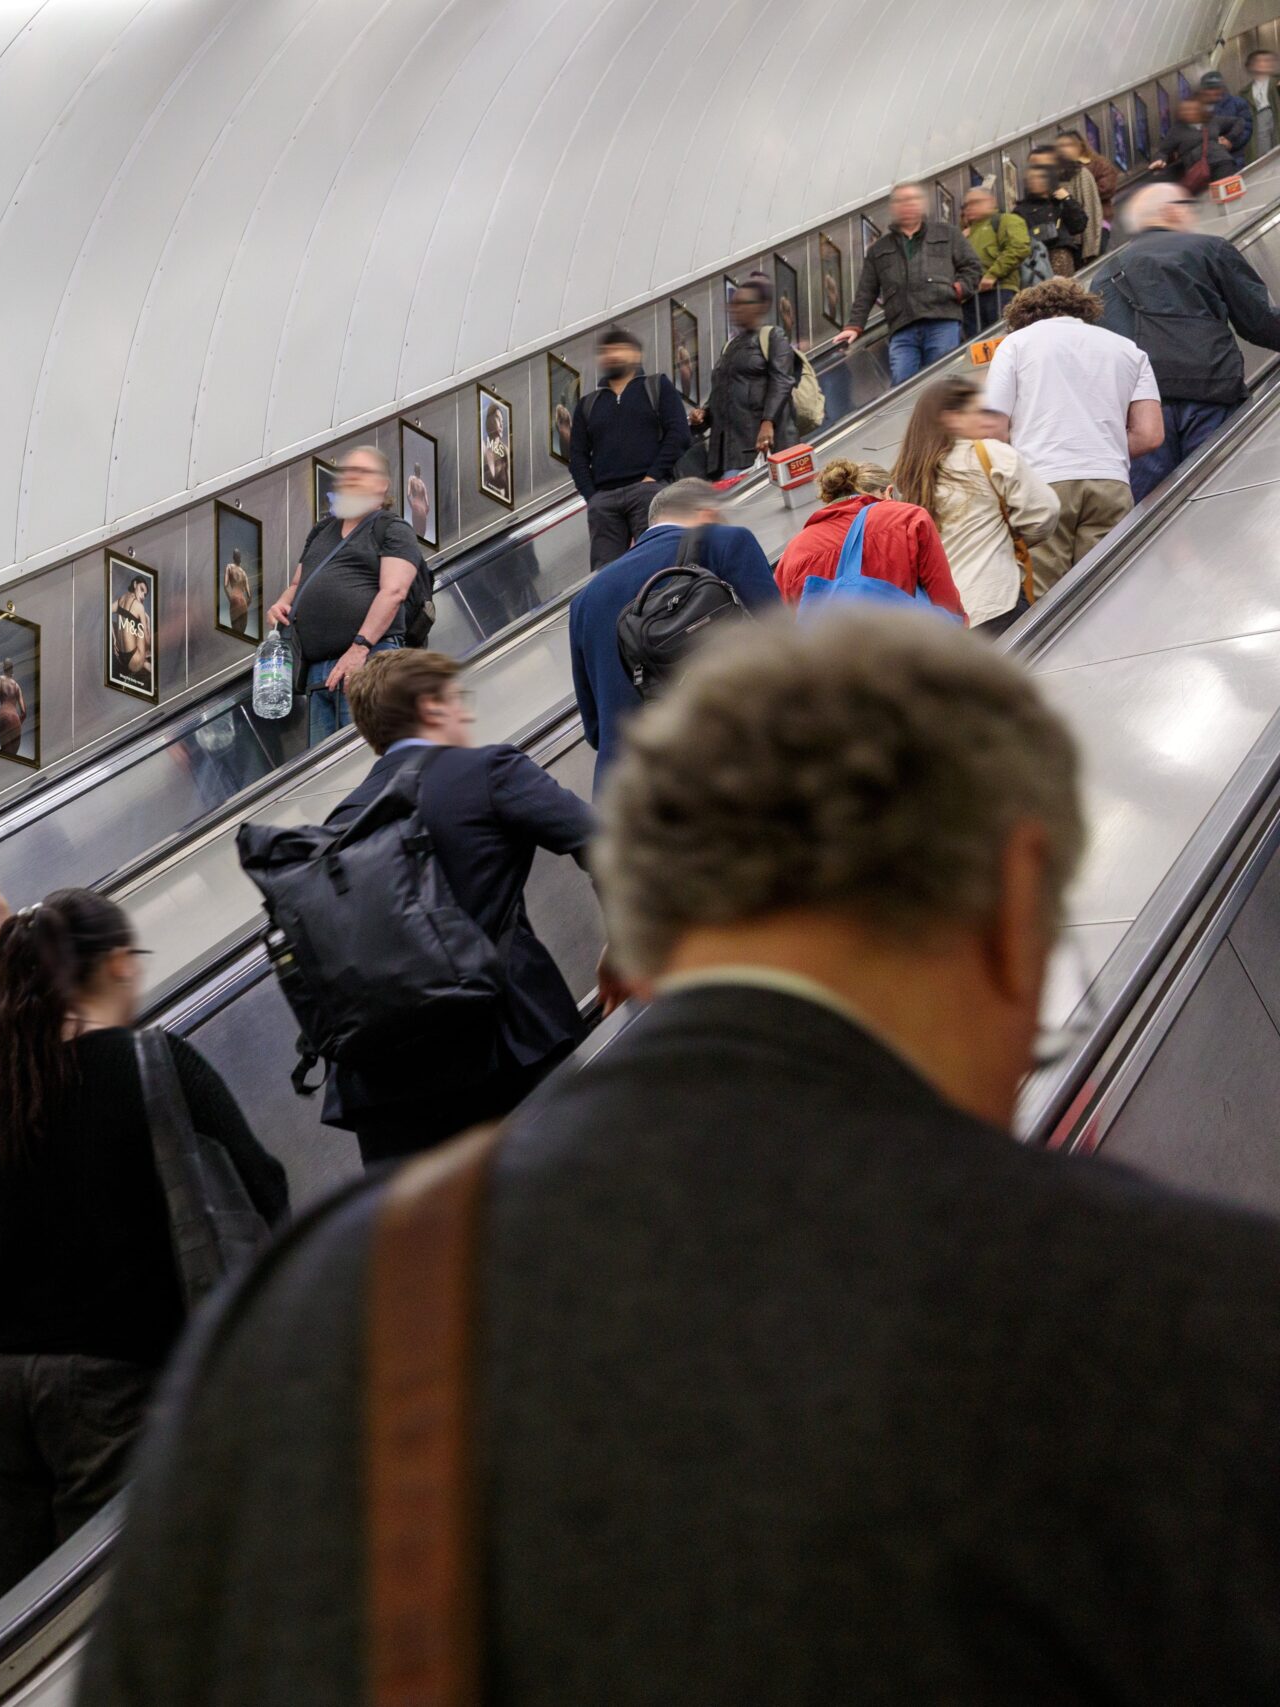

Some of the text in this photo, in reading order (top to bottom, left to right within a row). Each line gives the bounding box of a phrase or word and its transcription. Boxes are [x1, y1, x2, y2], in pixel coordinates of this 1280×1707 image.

[487, 437, 504, 457] M&S
[790, 457, 810, 470] STOP
[118, 614, 144, 639] M&S
